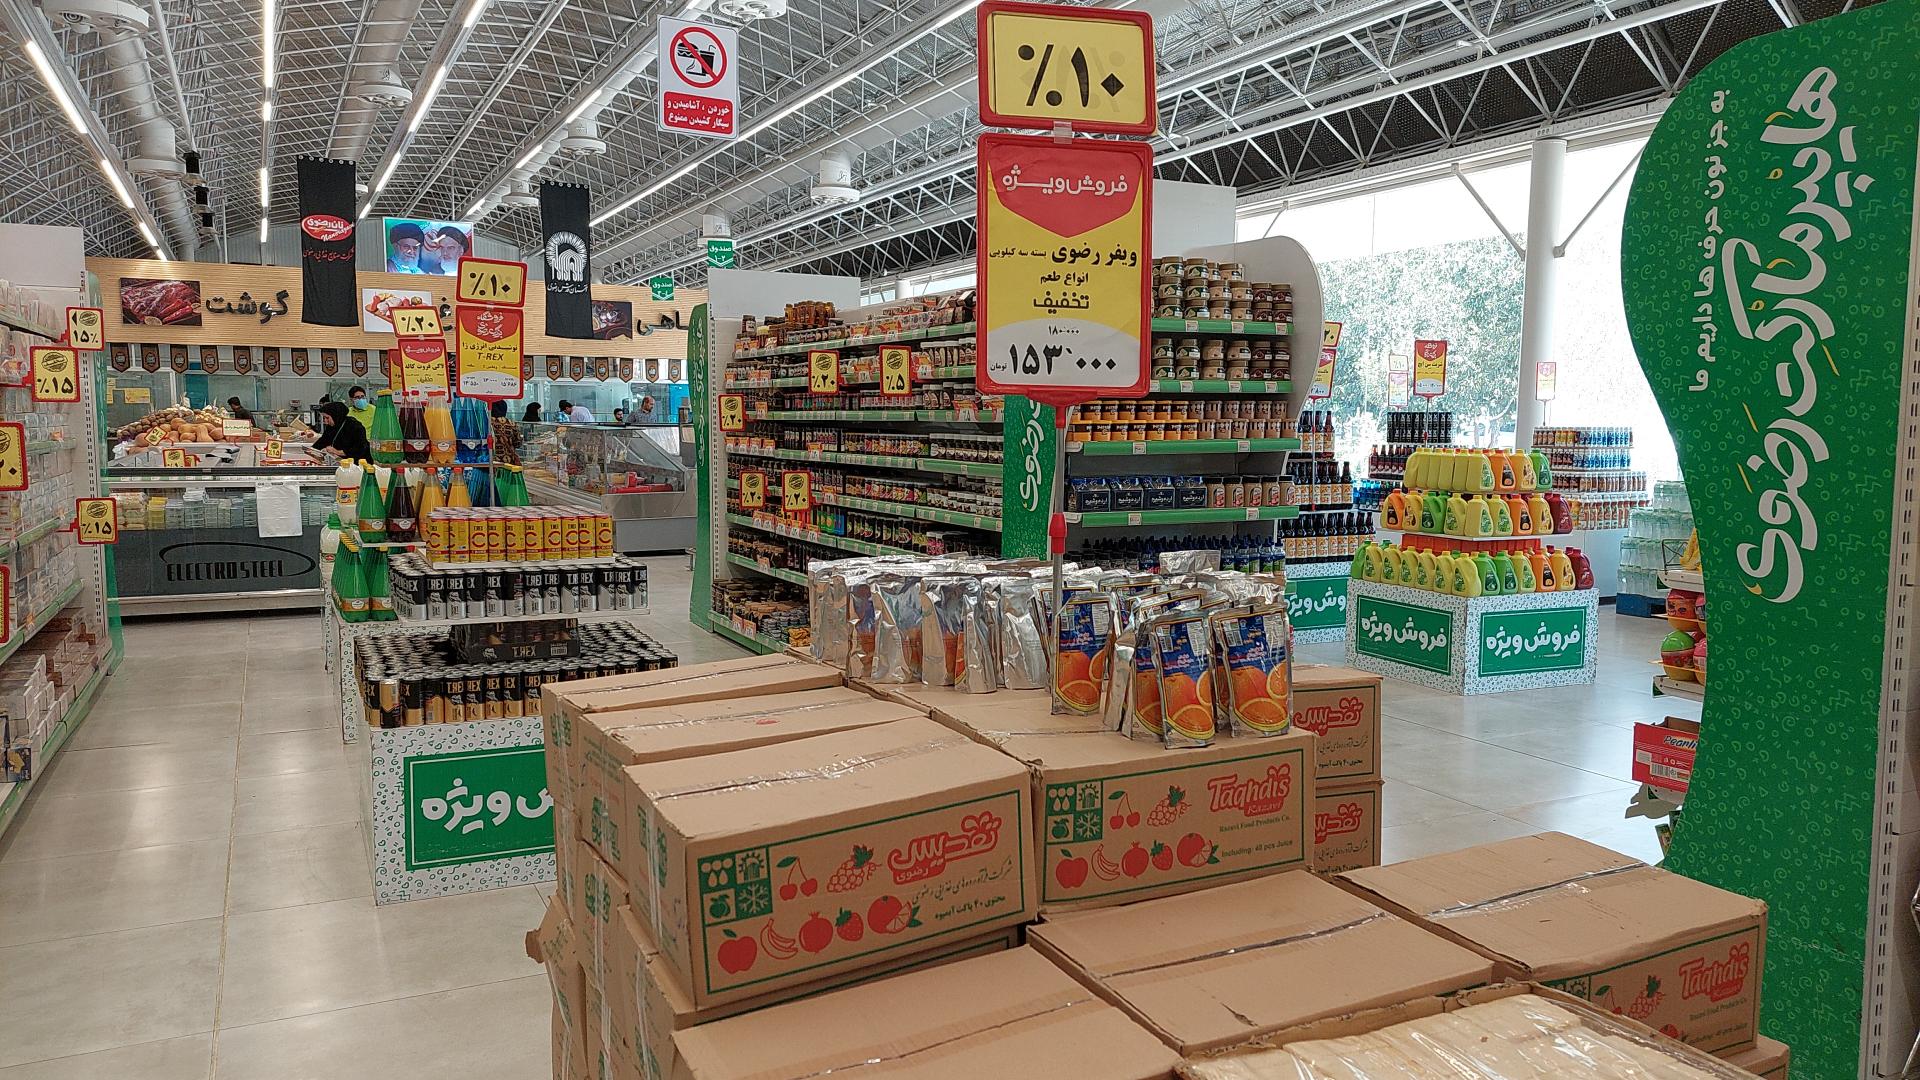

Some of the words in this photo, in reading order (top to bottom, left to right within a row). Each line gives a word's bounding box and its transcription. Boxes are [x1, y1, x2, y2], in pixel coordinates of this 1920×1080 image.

[672, 100, 700, 110] آشامیدن
[708, 105, 730, 116] خوردن
[1709, 90, 1731, 114] به
[668, 112, 688, 123] ممنوع
[688, 116, 711, 127] کشیدن
[711, 118, 730, 129] سیگار
[1705, 119, 1729, 149] جز
[1703, 155, 1728, 200] نون
[989, 247, 1018, 259] کیلویی
[1017, 249, 1029, 258] سه
[1030, 249, 1048, 258] بسته
[1051, 242, 1101, 266] رضوی
[1105, 243, 1138, 267] ویفر
[1040, 271, 1062, 285] طعم
[1063, 272, 1090, 287] انواع
[205, 290, 290, 325] گوشت
[1033, 291, 1090, 315] تخفیف
[1692, 302, 1718, 363] داریم
[477, 352, 505, 361] T-REX
[990, 361, 1008, 373] تومان
[1689, 369, 1709, 393] ما
[1361, 610, 1392, 642] ویژه
[1393, 616, 1447, 652] فروش
[1524, 621, 1581, 652] فروش
[1486, 625, 1523, 659] ویژه
[421, 777, 512, 835] ویژه
[887, 811, 1003, 873] تقدیس
